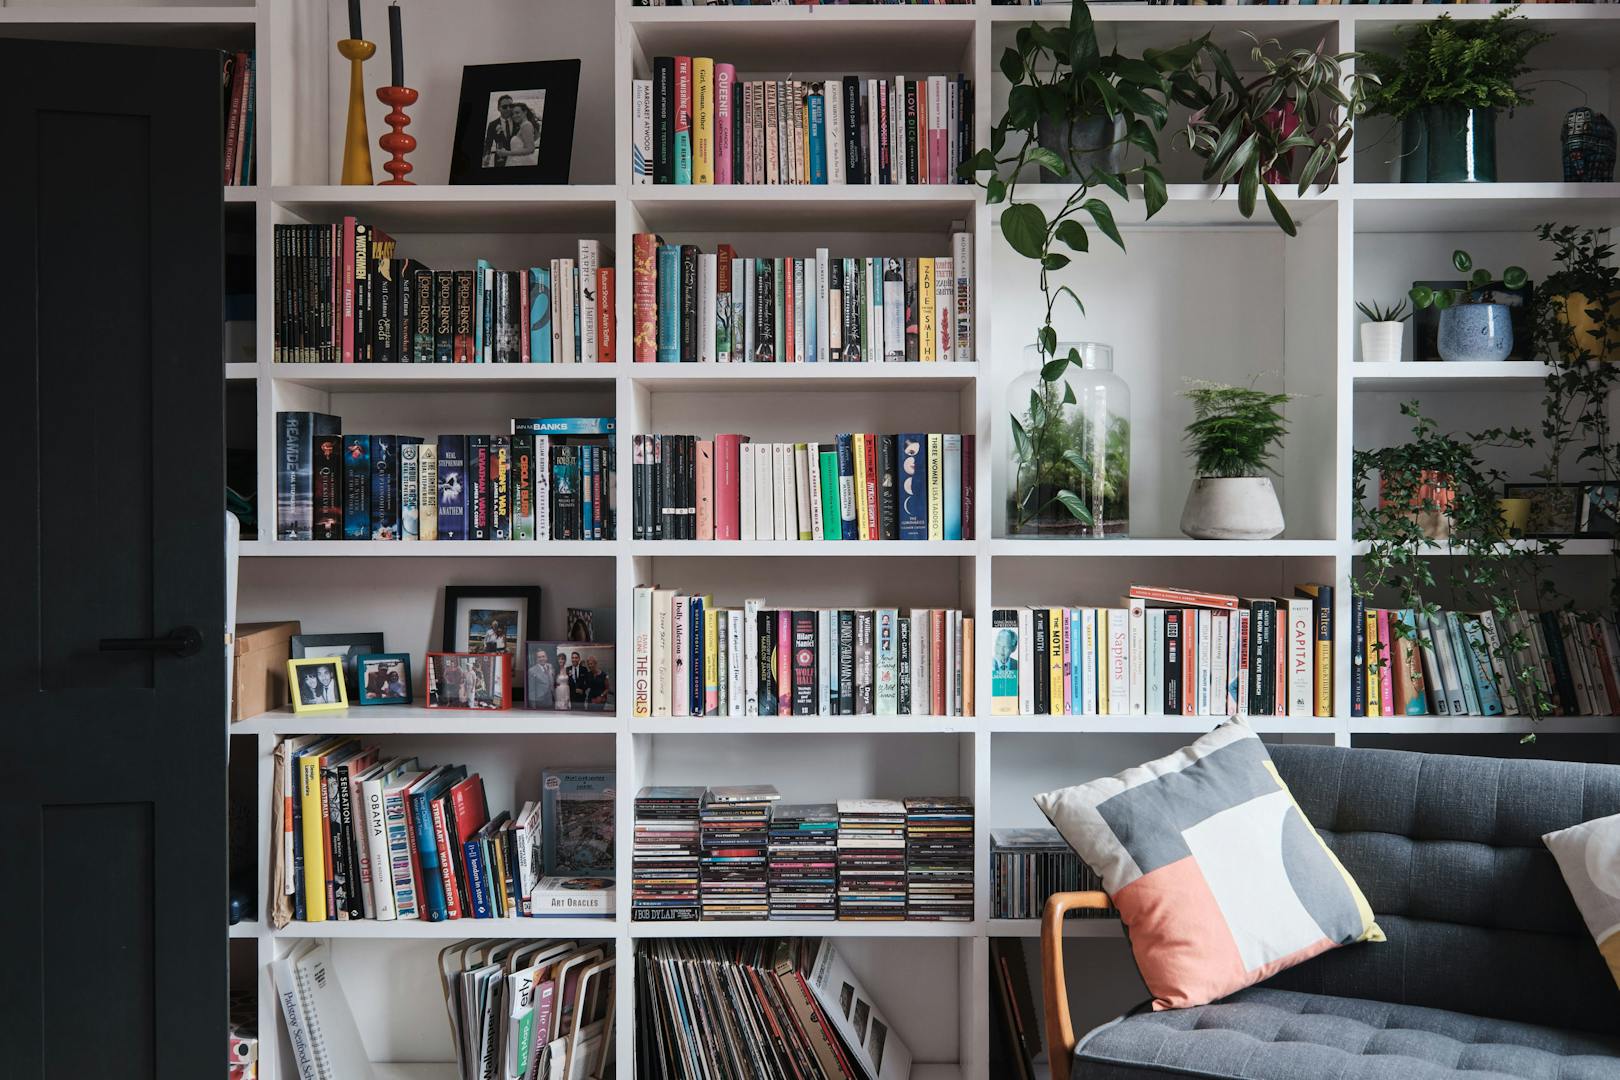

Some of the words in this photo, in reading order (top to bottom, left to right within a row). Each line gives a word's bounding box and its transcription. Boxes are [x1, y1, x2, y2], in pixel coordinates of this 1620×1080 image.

[718, 72, 728, 117] QUEENIE
[767, 84, 776, 103] MAYA
[907, 92, 915, 117] LOVE
[767, 102, 776, 128] ANGELOU
[907, 119, 915, 143] DICK
[355, 235, 367, 280] WATCHMEN
[582, 245, 590, 283] HARRIS
[719, 249, 729, 262] Ali
[418, 275, 431, 298] LORD
[438, 275, 451, 298] LORD
[719, 263, 729, 292] Smith
[794, 260, 803, 306] BROOKLYN
[957, 277, 968, 315] BRICK
[378, 319, 386, 340] Gods
[418, 305, 430, 334] RINGS
[438, 305, 450, 335] RINGS
[458, 305, 470, 334] RINGS
[585, 306, 594, 344] IMPERIUM
[957, 318, 968, 348] LANE
[533, 423, 568, 431] BANKS
[286, 419, 300, 471] REAMDE
[408, 462, 417, 482] SNOW
[428, 461, 436, 471] THE
[478, 448, 486, 494] LEVIATHAN
[498, 448, 507, 493] CALIBAN'S
[520, 454, 529, 488] CIBOLA
[320, 467, 331, 514] QUICKSILVER
[376, 460, 387, 523] CRYPTONOMICON
[408, 484, 417, 507] CRASH
[428, 472, 436, 494] DIAMOND
[428, 496, 436, 506] AGE
[438, 506, 464, 516] ANATHEM
[478, 497, 486, 527] WAKES
[498, 495, 507, 516] WAR
[520, 489, 529, 517] BURN
[883, 490, 892, 528] WATERS
[674, 602, 683, 621] Dolly
[1320, 607, 1331, 636] Falter
[1036, 620, 1044, 630] THE
[1167, 623, 1178, 638] LOGO
[1241, 621, 1249, 635] GOOD
[674, 622, 683, 654] Alderton
[795, 639, 814, 648] Mantel
[1036, 631, 1044, 651] MOTH
[1052, 630, 1061, 657] MOTH
[1295, 620, 1306, 674] CAPITAL
[1111, 632, 1126, 681] Sapiens
[1241, 636, 1249, 668] IMMIGRANT
[636, 655, 648, 676] THE
[795, 668, 814, 677] WOLF
[796, 676, 813, 685] HALL
[636, 679, 648, 714] GIRLS
[863, 686, 871, 704] Days
[321, 782, 329, 818] AUSTRALIA
[340, 776, 351, 824] SENSATION
[370, 794, 382, 837] OBAMA
[432, 803, 442, 829] STREET
[409, 825, 417, 854] AUSTRALIA
[436, 829, 444, 843] ART
[439, 851, 448, 868] WAR
[471, 858, 480, 882] london
[442, 868, 450, 879] ON
[396, 890, 415, 916] BOOK
[444, 878, 454, 907] TERROR
[475, 888, 484, 905] store
[551, 898, 565, 907] ART
[567, 898, 599, 907] ORACLES
[638, 909, 651, 920] BOB
[651, 909, 675, 920] DYLAN
[539, 1003, 552, 1025] The
[521, 1025, 530, 1049] Map
[520, 1050, 528, 1067] Art
